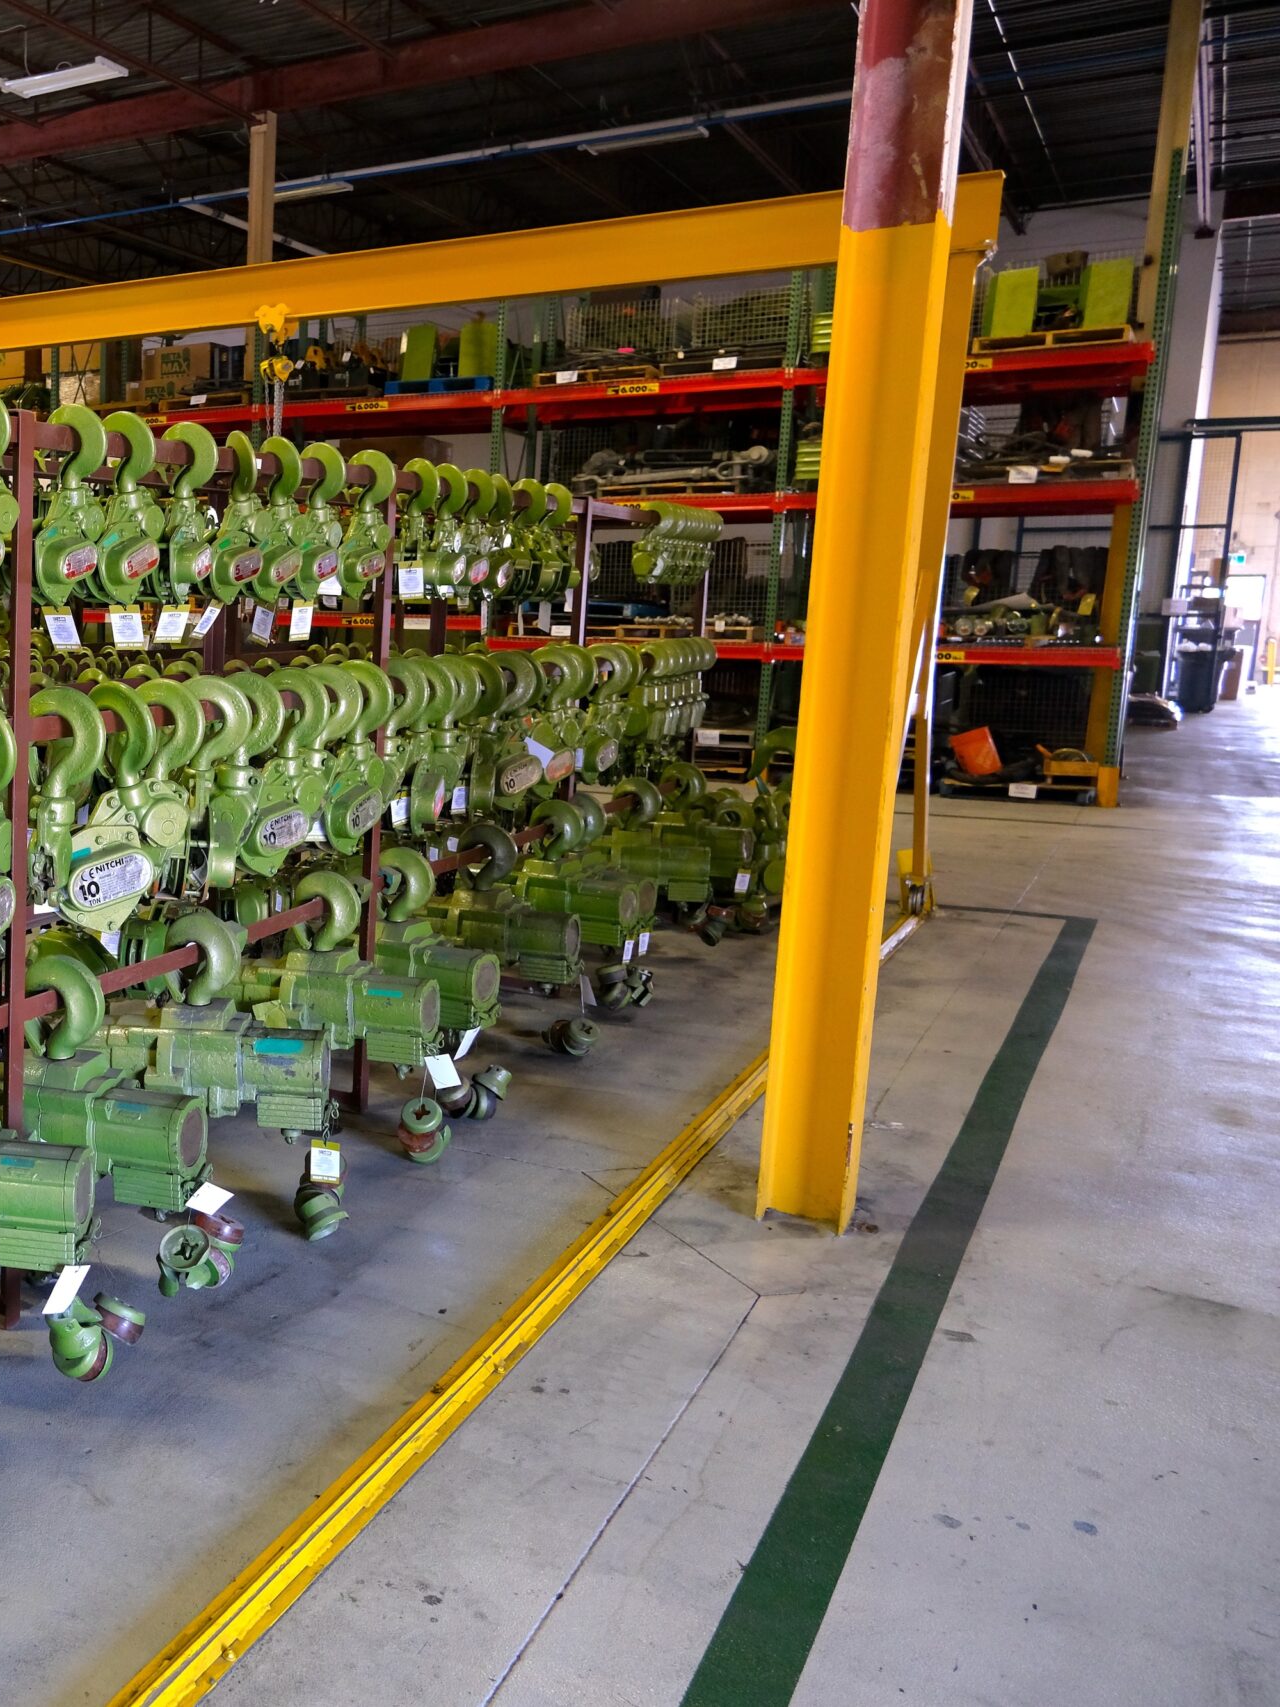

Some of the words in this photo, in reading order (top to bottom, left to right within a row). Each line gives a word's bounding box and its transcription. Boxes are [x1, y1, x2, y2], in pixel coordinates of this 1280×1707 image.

[162, 361, 189, 375] MAX
[127, 561, 134, 572] 5
[235, 565, 241, 575] 5
[318, 562, 323, 573] 5
[505, 778, 516, 791] 10
[352, 815, 360, 829] 10
[263, 831, 277, 845] 10
[95, 858, 125, 874] NITCHI
[79, 881, 100, 901] 10
